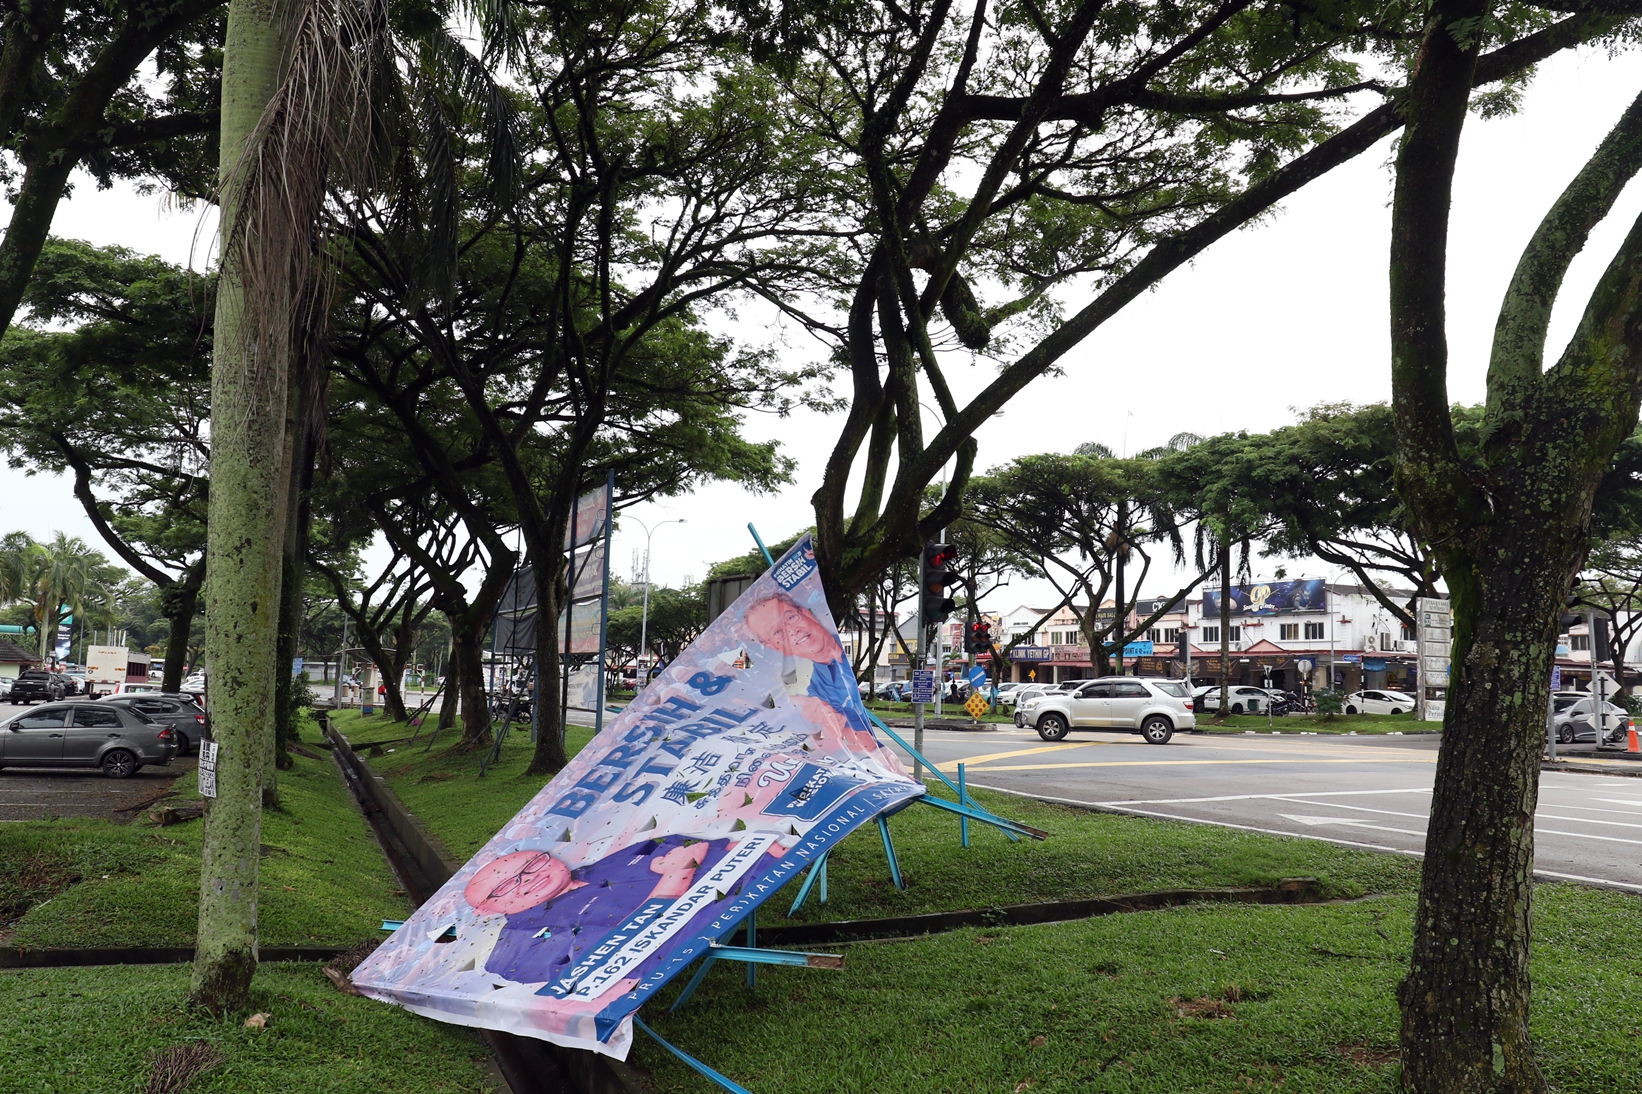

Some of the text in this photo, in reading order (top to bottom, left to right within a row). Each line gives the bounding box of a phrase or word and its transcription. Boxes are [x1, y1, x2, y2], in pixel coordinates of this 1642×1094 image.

[777, 556, 807, 583] BERSIH
[782, 564, 813, 588] STABIL
[544, 696, 703, 819] BERSIH
[687, 671, 733, 697] &
[612, 708, 759, 806] STABIL
[575, 956, 633, 996] P.162
[628, 885, 715, 953] ISKANDAR
[710, 838, 766, 881] PUTERI
[622, 904, 664, 931] TAN
[627, 948, 693, 1000] PRU-15
[711, 861, 795, 929] PERIKATAN
[796, 806, 866, 858] NASIONAL
